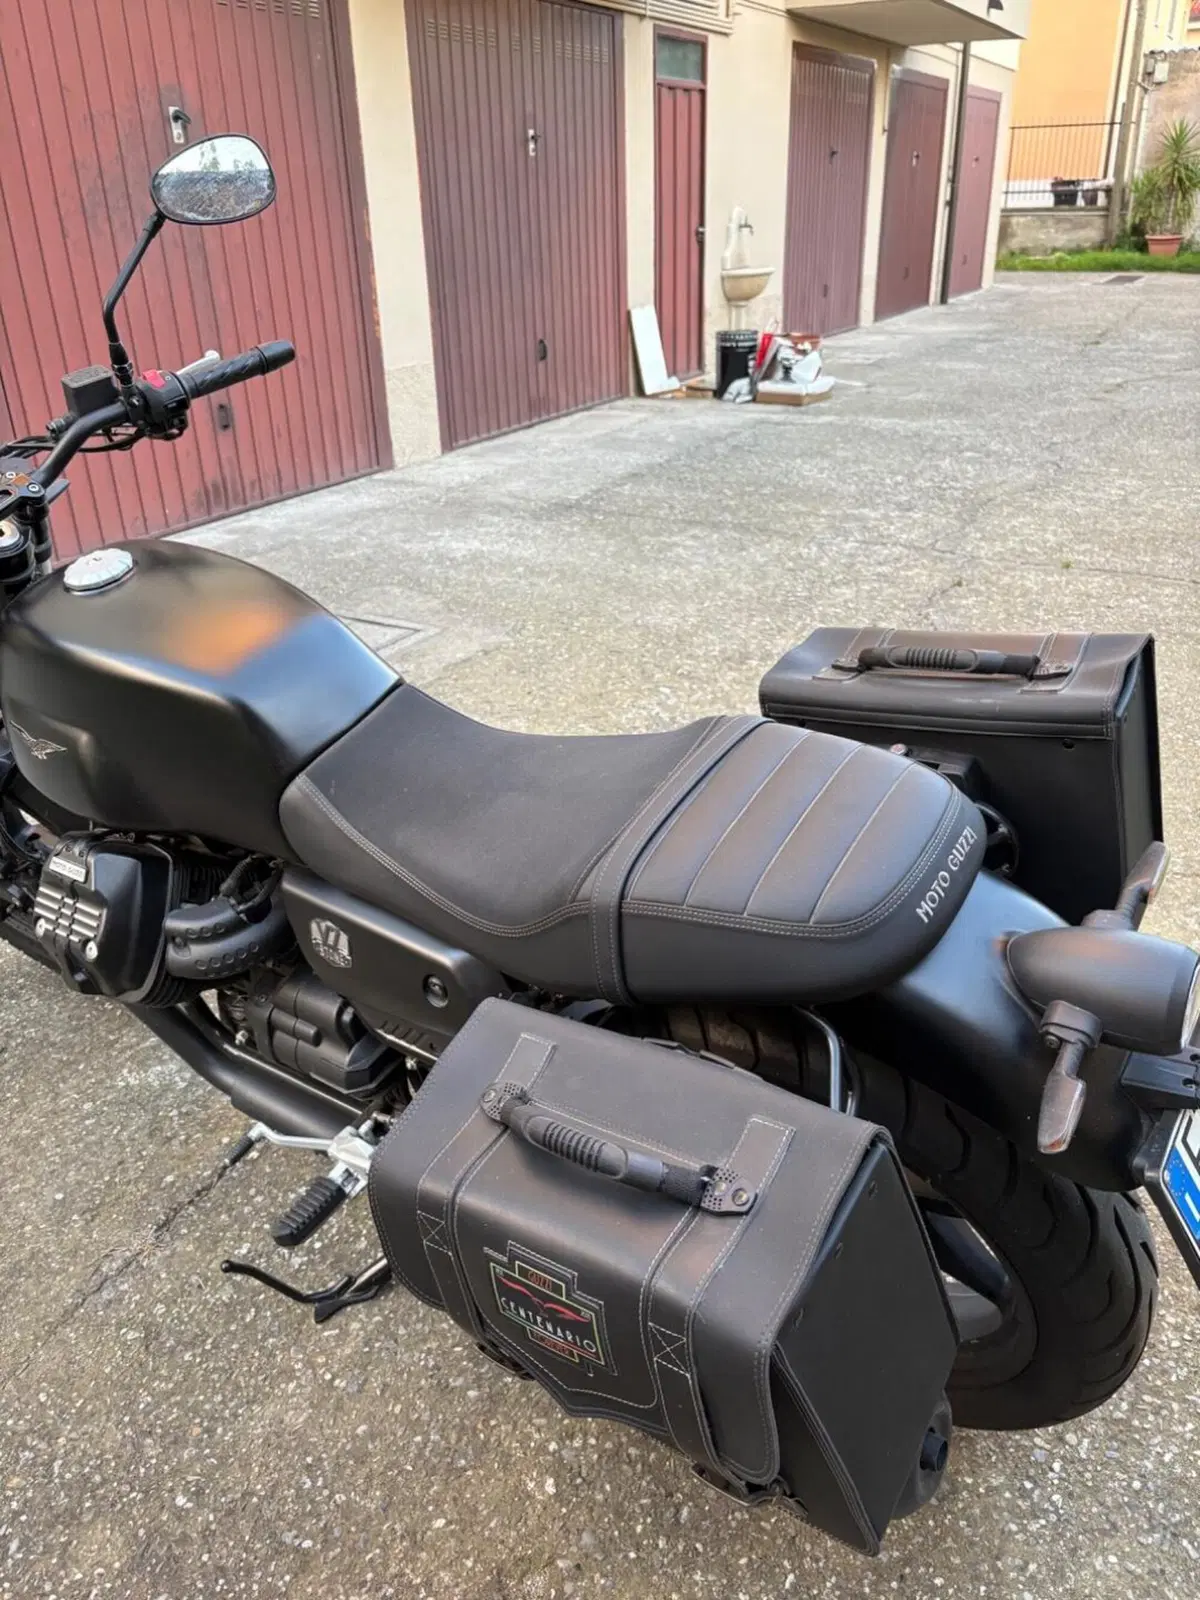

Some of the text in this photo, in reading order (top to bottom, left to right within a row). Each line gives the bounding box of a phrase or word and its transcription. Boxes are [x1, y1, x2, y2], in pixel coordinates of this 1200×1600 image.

[915, 826, 978, 923] MOTO GUZZI
[527, 1270, 553, 1292] GUZZI
[500, 1296, 597, 1353] CENTENARIO
